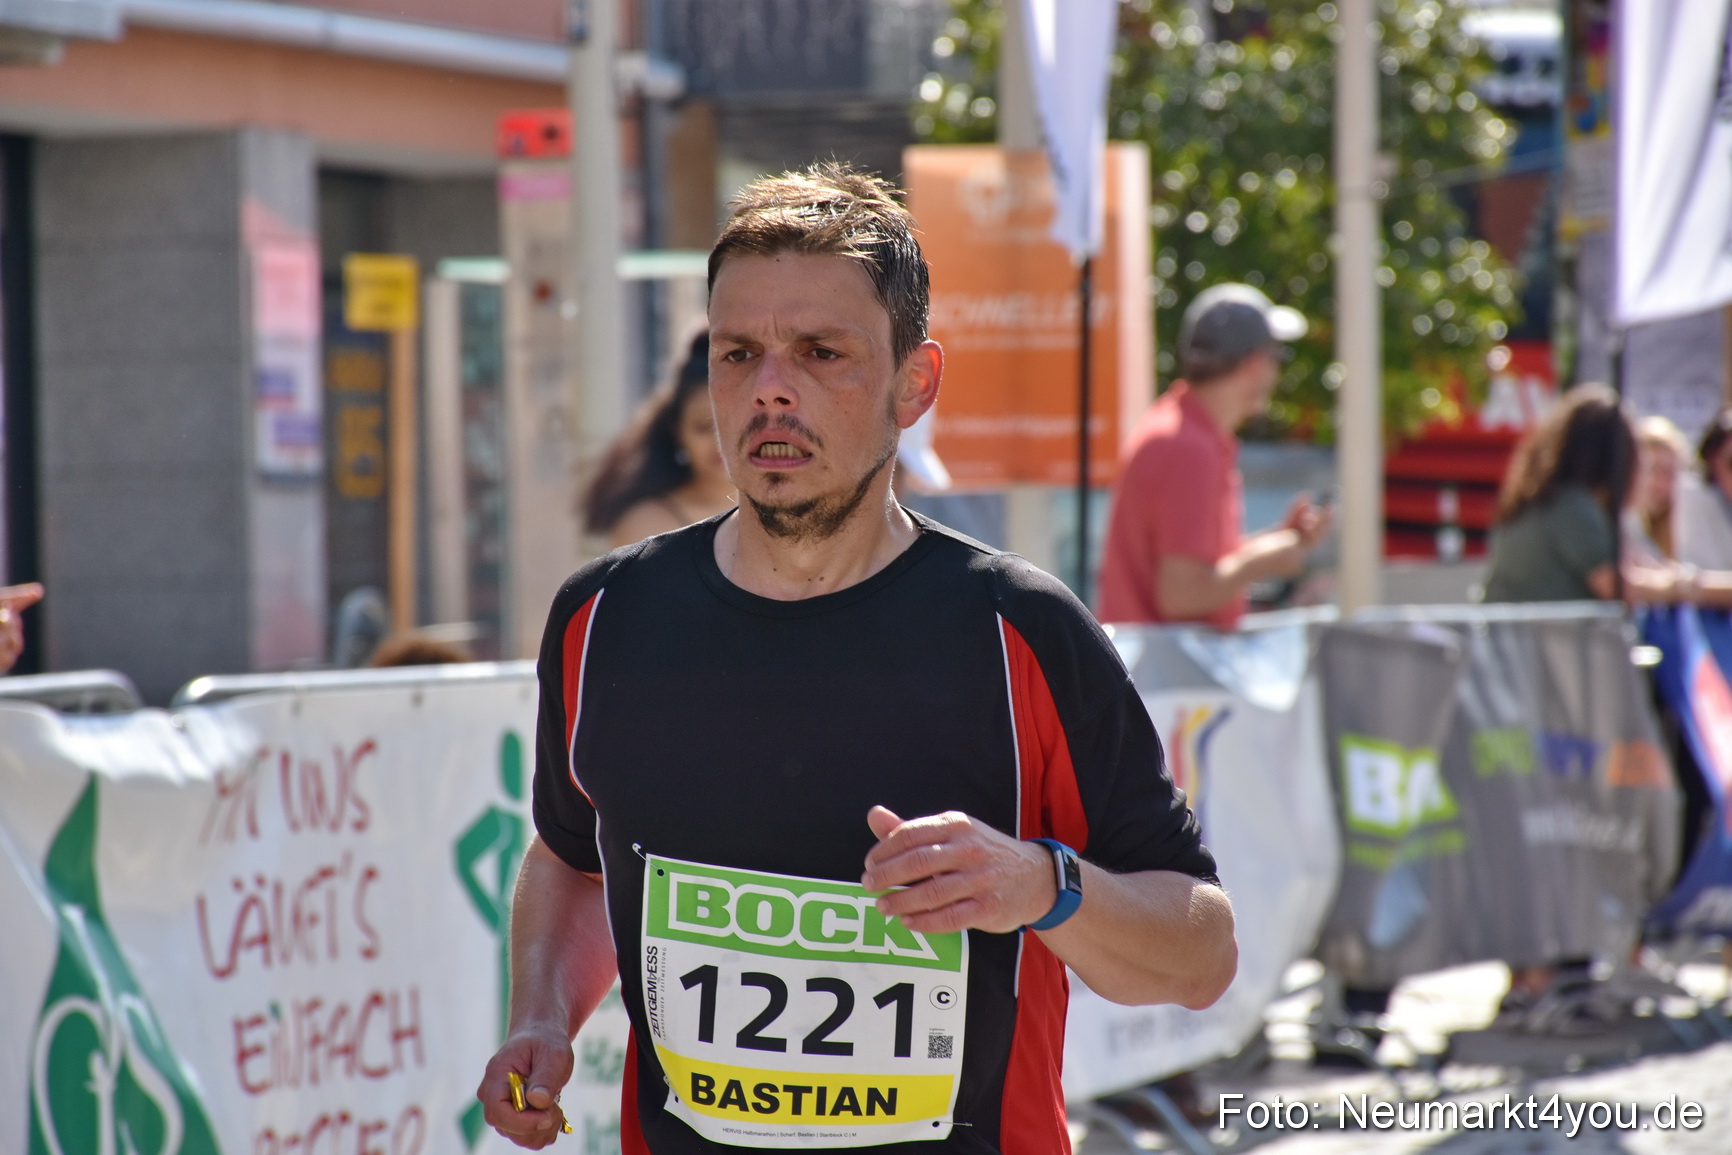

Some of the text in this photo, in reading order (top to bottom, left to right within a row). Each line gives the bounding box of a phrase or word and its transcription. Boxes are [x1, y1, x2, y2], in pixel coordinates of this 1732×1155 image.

[279, 739, 377, 834] UNS
[674, 878, 928, 954] BOCK
[679, 964, 915, 1058] 1221
[936, 991, 951, 1005] C
[690, 1072, 898, 1117] BASTIAN
[722, 1127, 742, 1135] HERVIS
[742, 1129, 776, 1137] Halbmarathon
